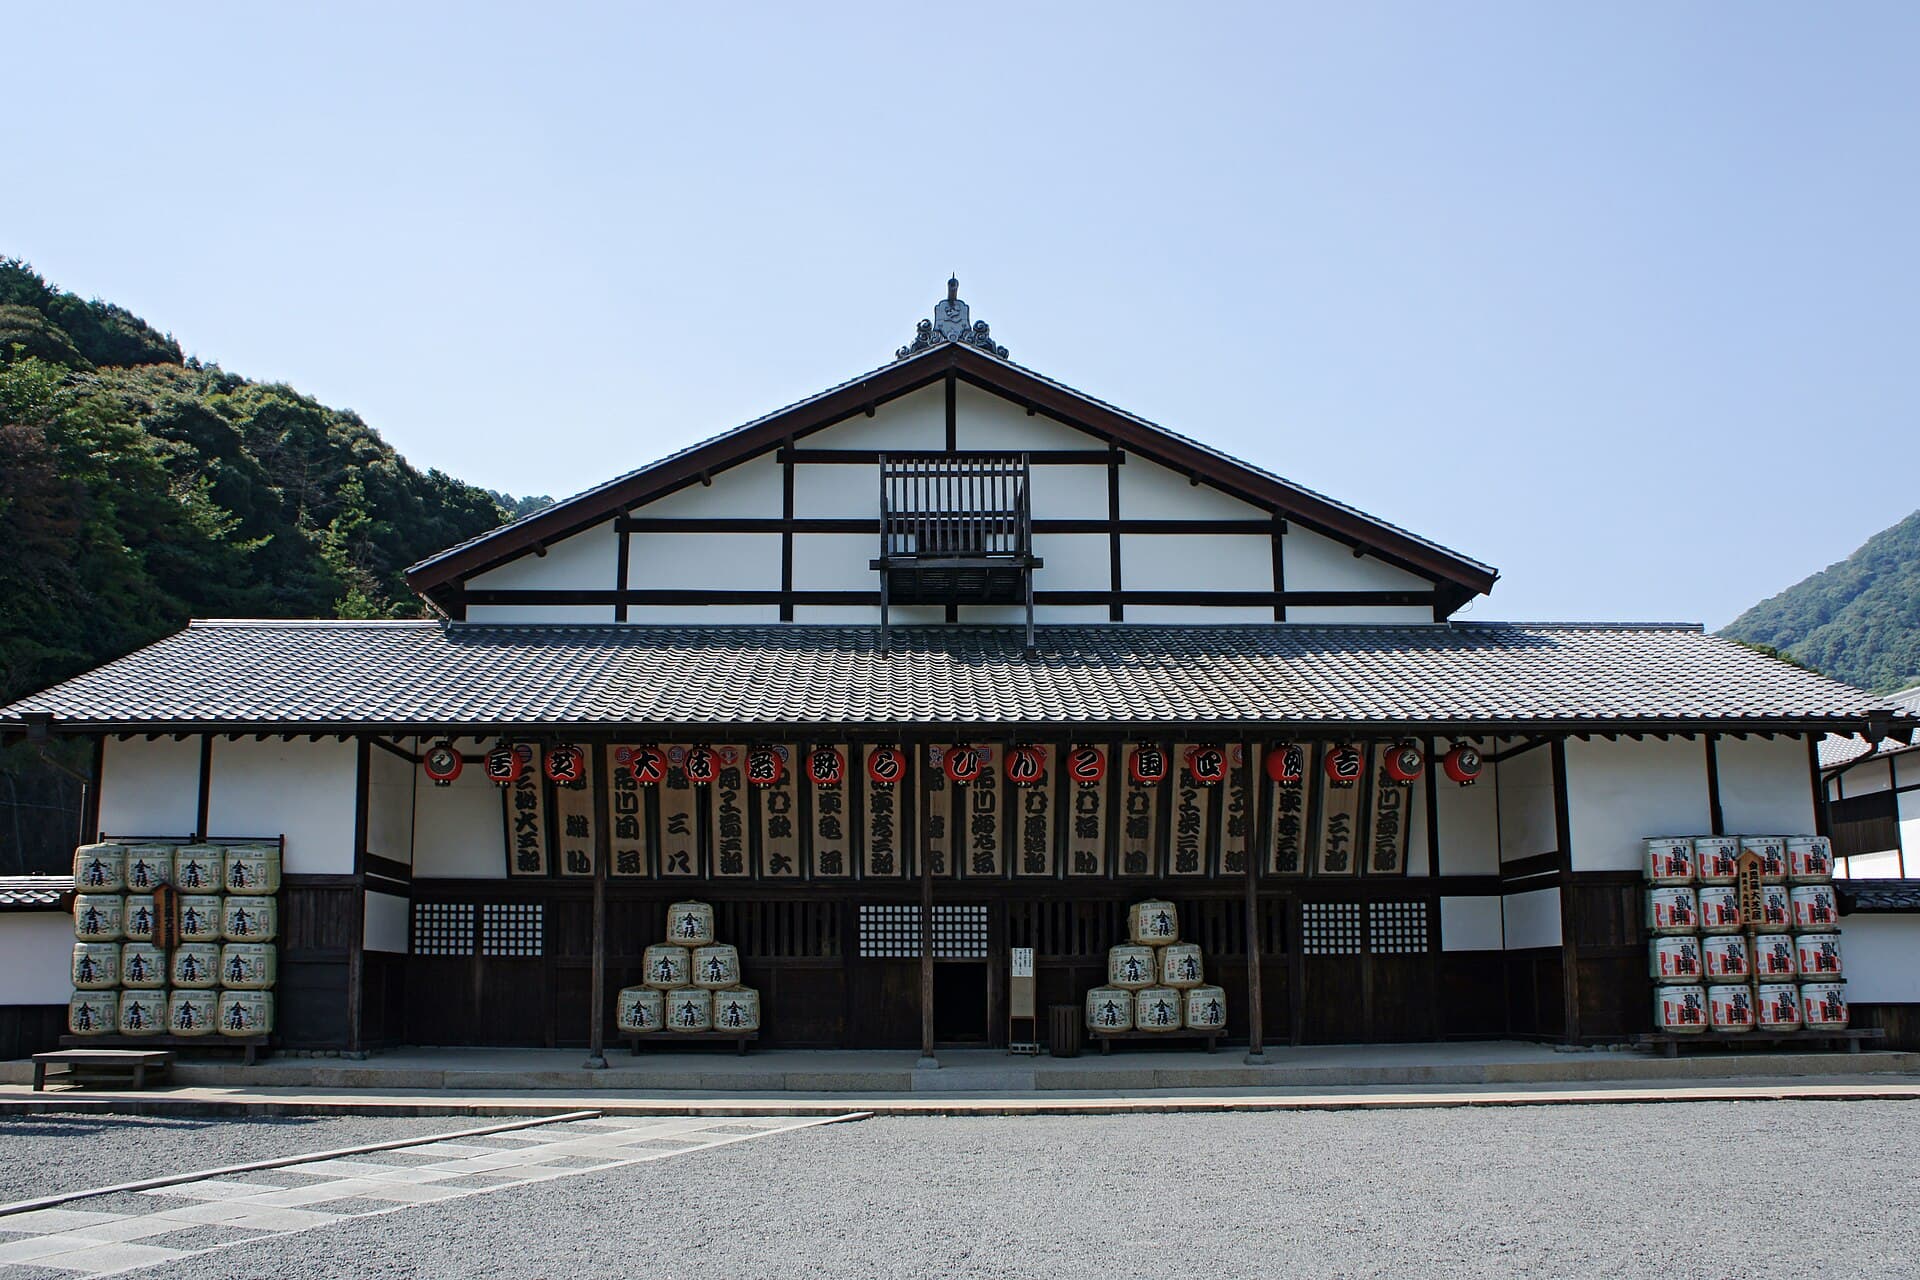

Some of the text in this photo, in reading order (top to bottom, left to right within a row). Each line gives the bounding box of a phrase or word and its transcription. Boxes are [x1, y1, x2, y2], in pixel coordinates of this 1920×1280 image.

[489, 751, 513, 776] 居
[551, 752, 576, 778] 芝
[634, 751, 659, 778] 大
[686, 750, 711, 778] 伎
[750, 752, 775, 779] 舞
[813, 752, 839, 779] 歌
[875, 752, 898, 777] ら
[1012, 752, 1037, 777] ん
[1075, 751, 1099, 777] こ
[1196, 751, 1221, 776] 四
[1334, 750, 1360, 777] 吉
